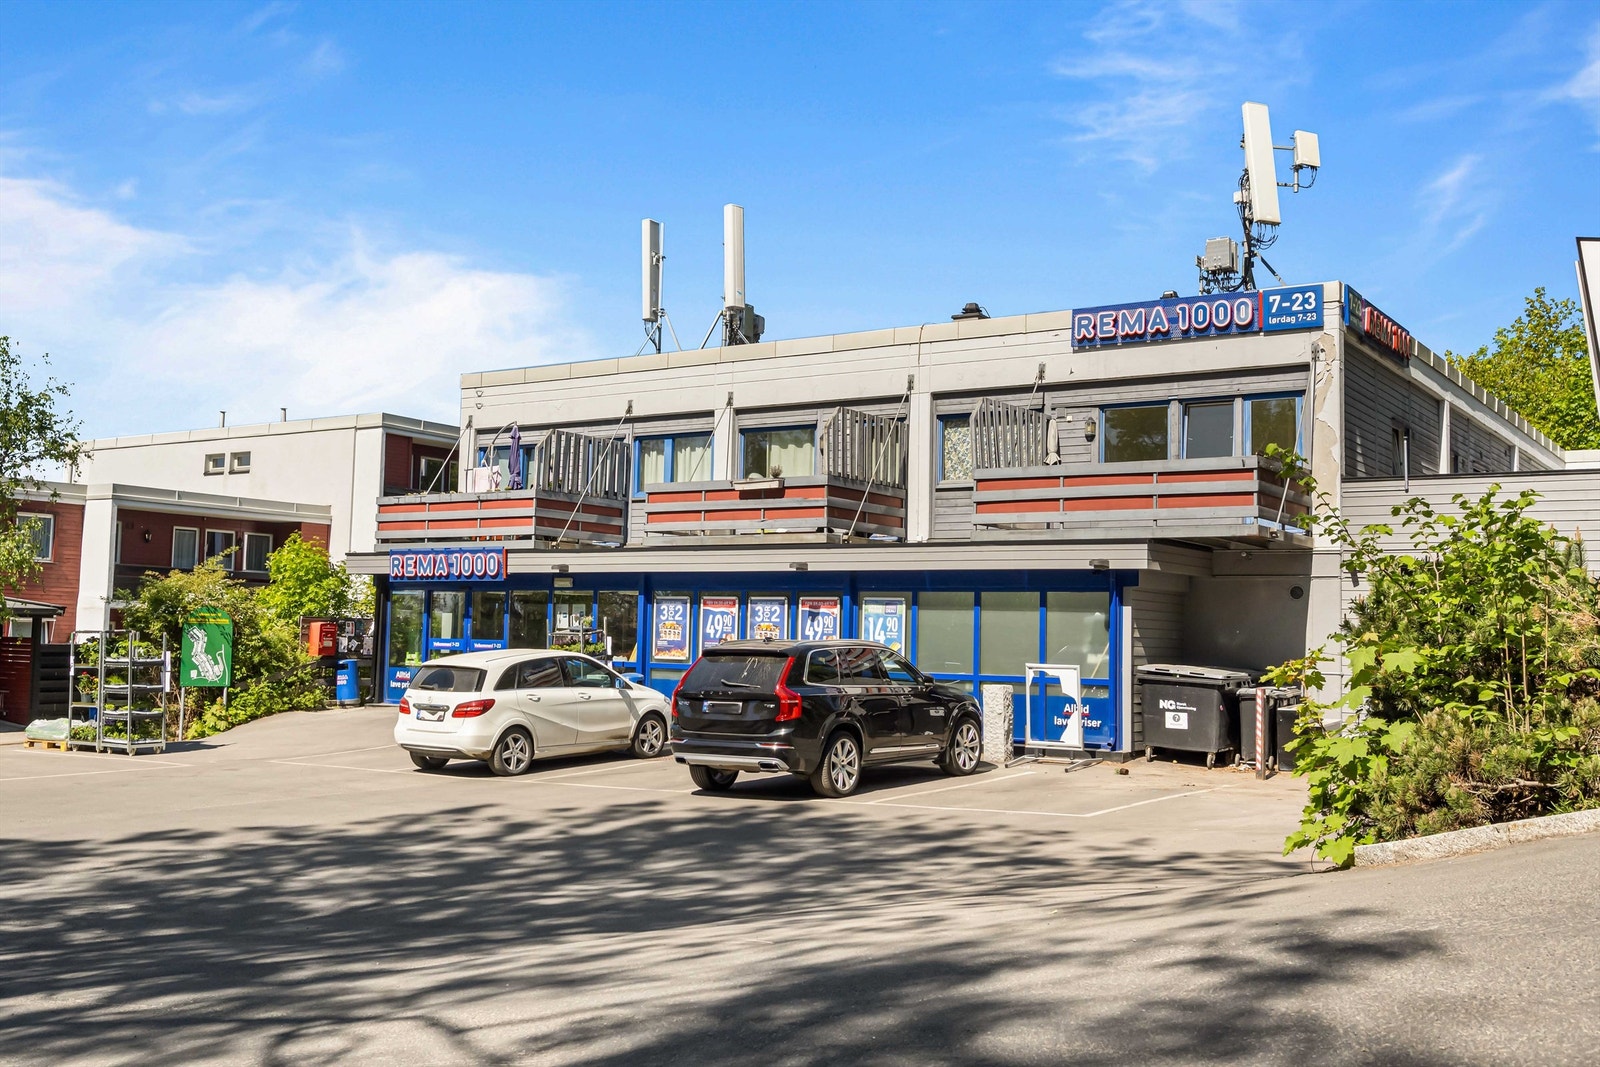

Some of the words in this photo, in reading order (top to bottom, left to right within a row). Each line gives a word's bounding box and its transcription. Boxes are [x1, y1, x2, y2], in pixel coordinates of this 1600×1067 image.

[1268, 291, 1316, 313] 7-23
[1075, 306, 1169, 340] REMA
[1177, 298, 1253, 330] 1000
[1268, 315, 1296, 324] lørdag
[1297, 312, 1317, 322] 7-23
[390, 553, 449, 577] REMA
[452, 552, 499, 576] 1000
[660, 605, 668, 620] 3
[674, 605, 683, 620] 2
[755, 606, 764, 622] 3
[763, 605, 771, 622] FOR
[771, 606, 780, 622] 2
[706, 614, 723, 639] 49
[723, 614, 733, 627] 90
[805, 615, 824, 640] 49
[823, 615, 834, 628] 90
[868, 617, 886, 645] 14
[886, 616, 899, 632] 90
[390, 680, 401, 688] lave
[1063, 703, 1090, 714] Allid
[1159, 699, 1176, 710] NG
[1081, 717, 1102, 728] riser
